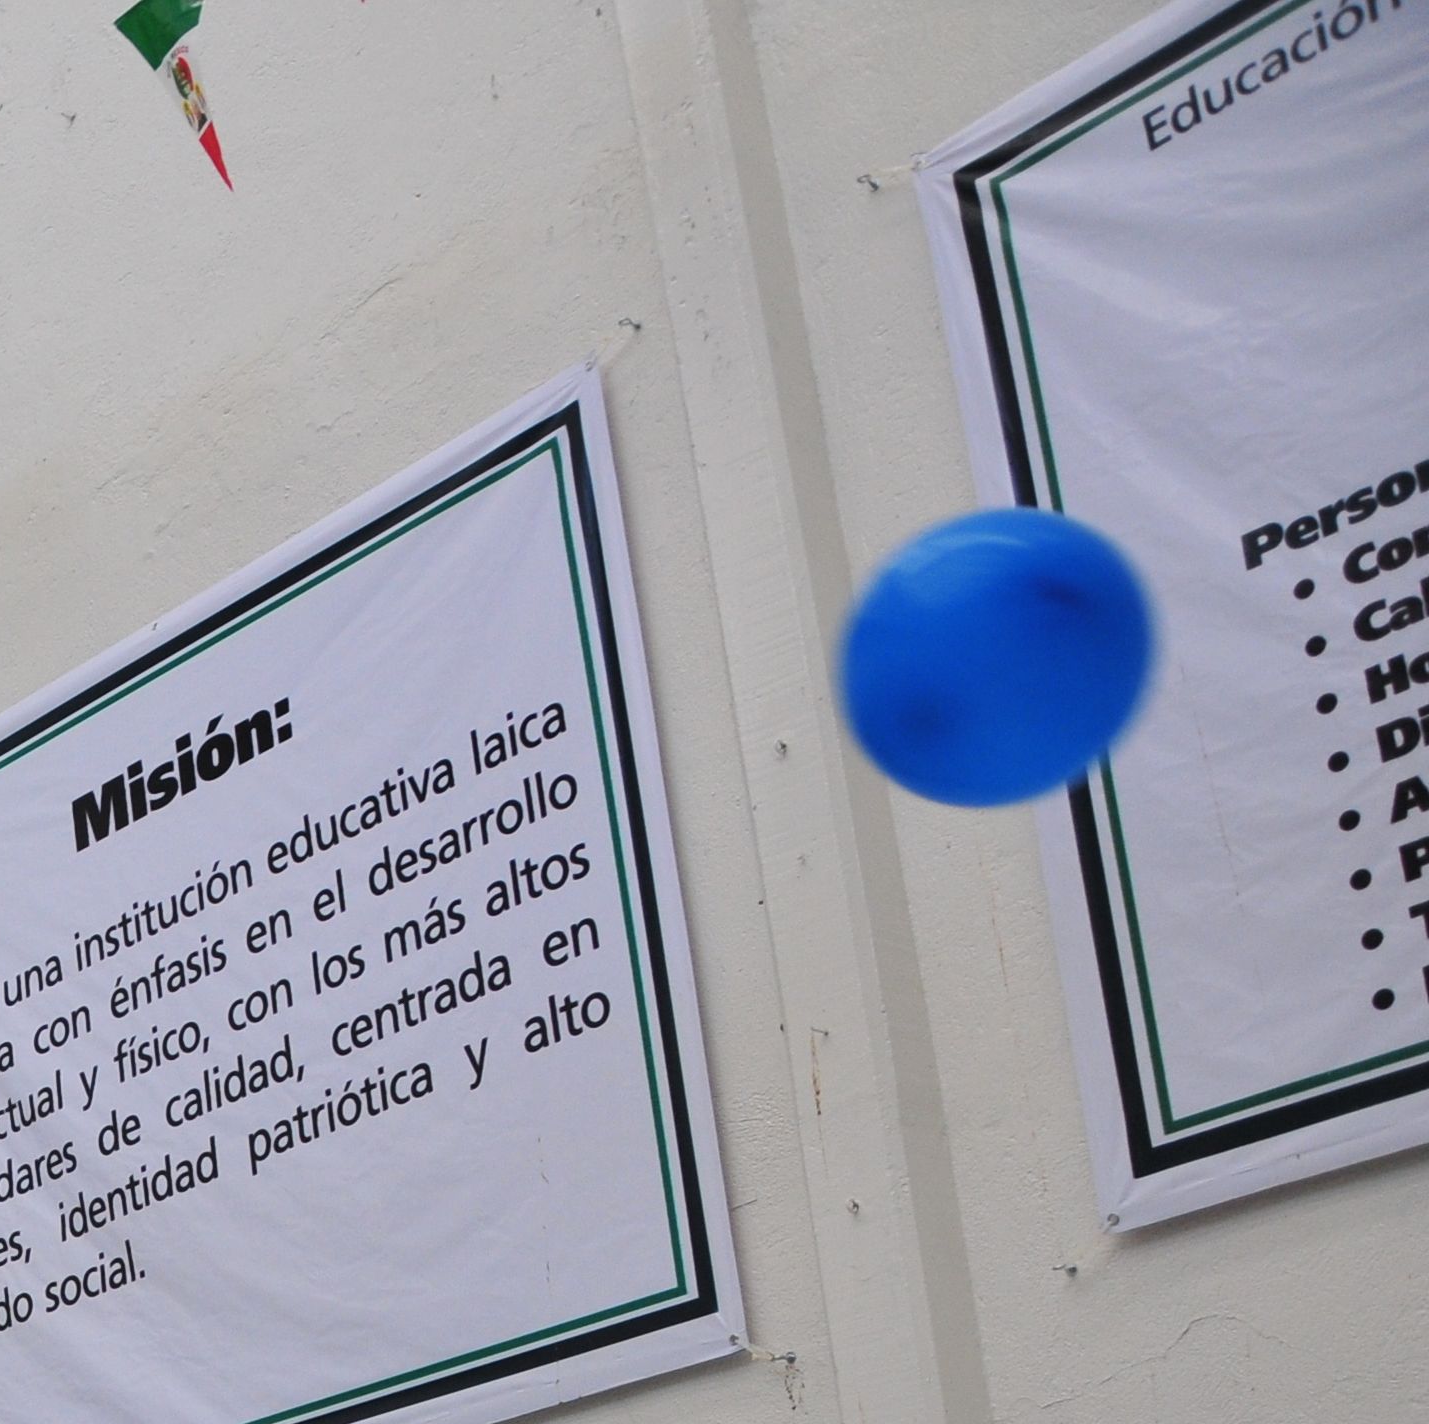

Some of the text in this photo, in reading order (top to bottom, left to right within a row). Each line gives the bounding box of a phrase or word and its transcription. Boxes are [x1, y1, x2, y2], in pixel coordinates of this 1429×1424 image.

[1241, 459, 1429, 570] Perso
[2, 954, 63, 1007] una
[73, 858, 253, 972] institución
[266, 757, 455, 874] educativa
[469, 701, 567, 775] laica
[70, 696, 293, 852] Misión:
[32, 1004, 91, 1054] con
[109, 934, 227, 1019] énfasis
[245, 908, 293, 954] en
[312, 867, 346, 922] el
[367, 770, 578, 896] desarrollo
[78, 1064, 98, 1112] y
[112, 1020, 210, 1083] físico,
[226, 977, 293, 1031] con
[311, 943, 366, 995] los
[383, 895, 466, 963] más
[485, 841, 590, 917] altos
[57, 1134, 219, 1242] identidad
[247, 1061, 434, 1176] patriótica
[462, 1036, 488, 1091] y
[523, 990, 611, 1053] alto
[97, 1108, 141, 1156] de
[164, 1032, 305, 1127] calidad,
[330, 949, 512, 1057] centrada
[541, 917, 600, 967] en
[44, 1238, 146, 1313] social.
